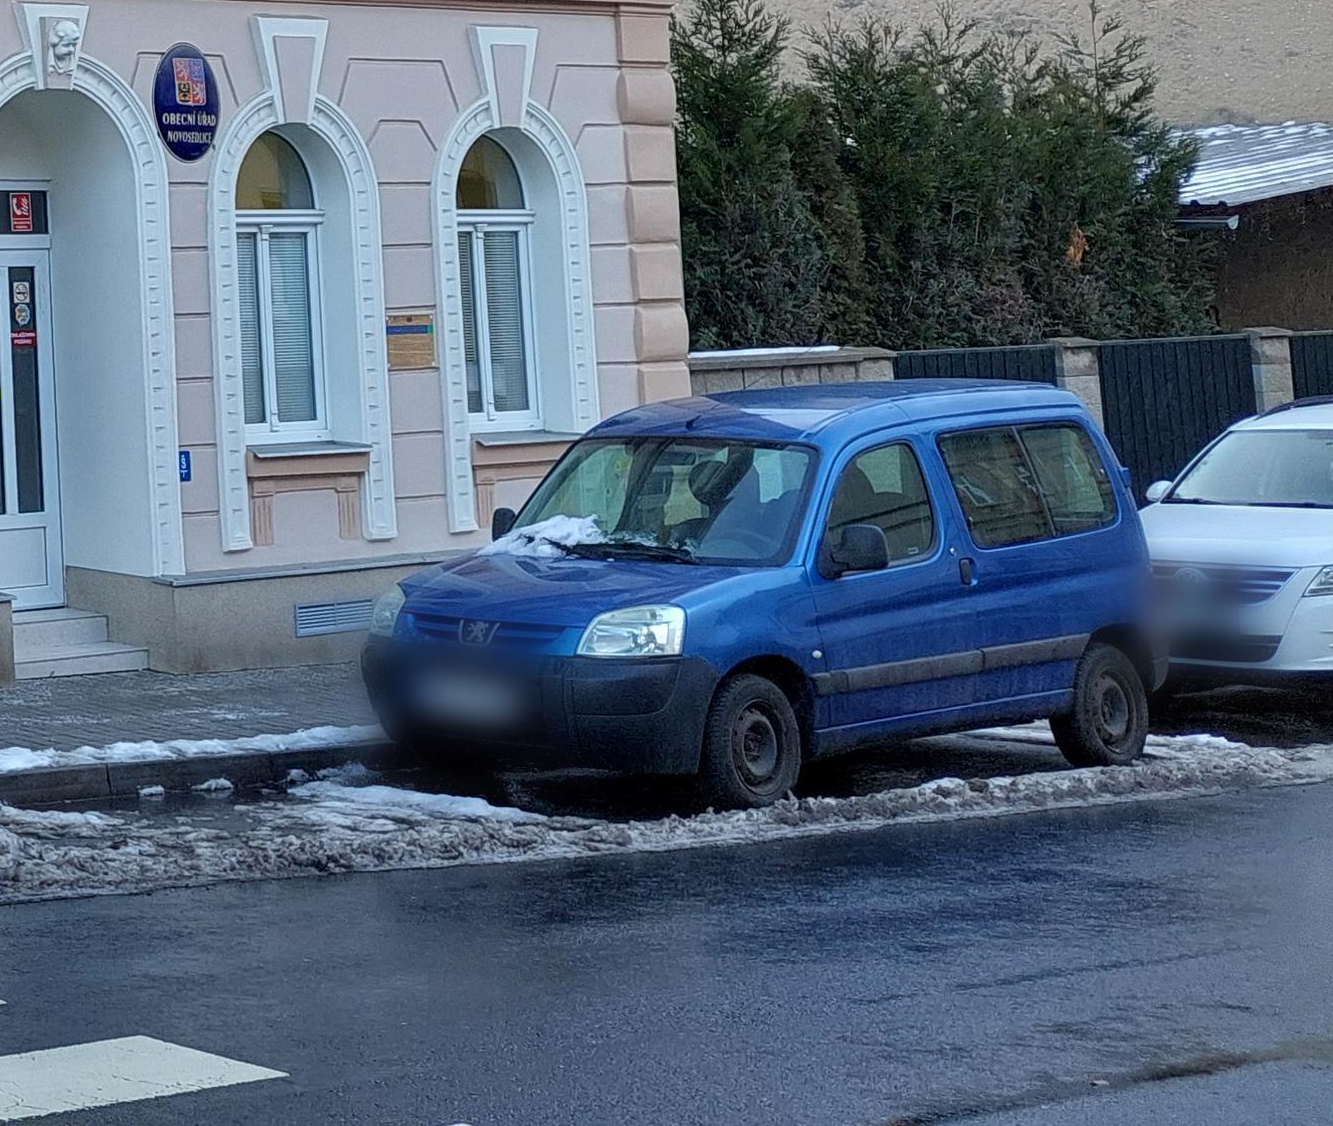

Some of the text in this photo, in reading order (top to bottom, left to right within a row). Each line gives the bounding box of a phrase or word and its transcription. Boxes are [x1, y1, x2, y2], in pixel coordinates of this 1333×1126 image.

[162, 110, 216, 126] OBECNÍ ÚŘAD
[166, 130, 212, 144] NOVOSEDLICE
